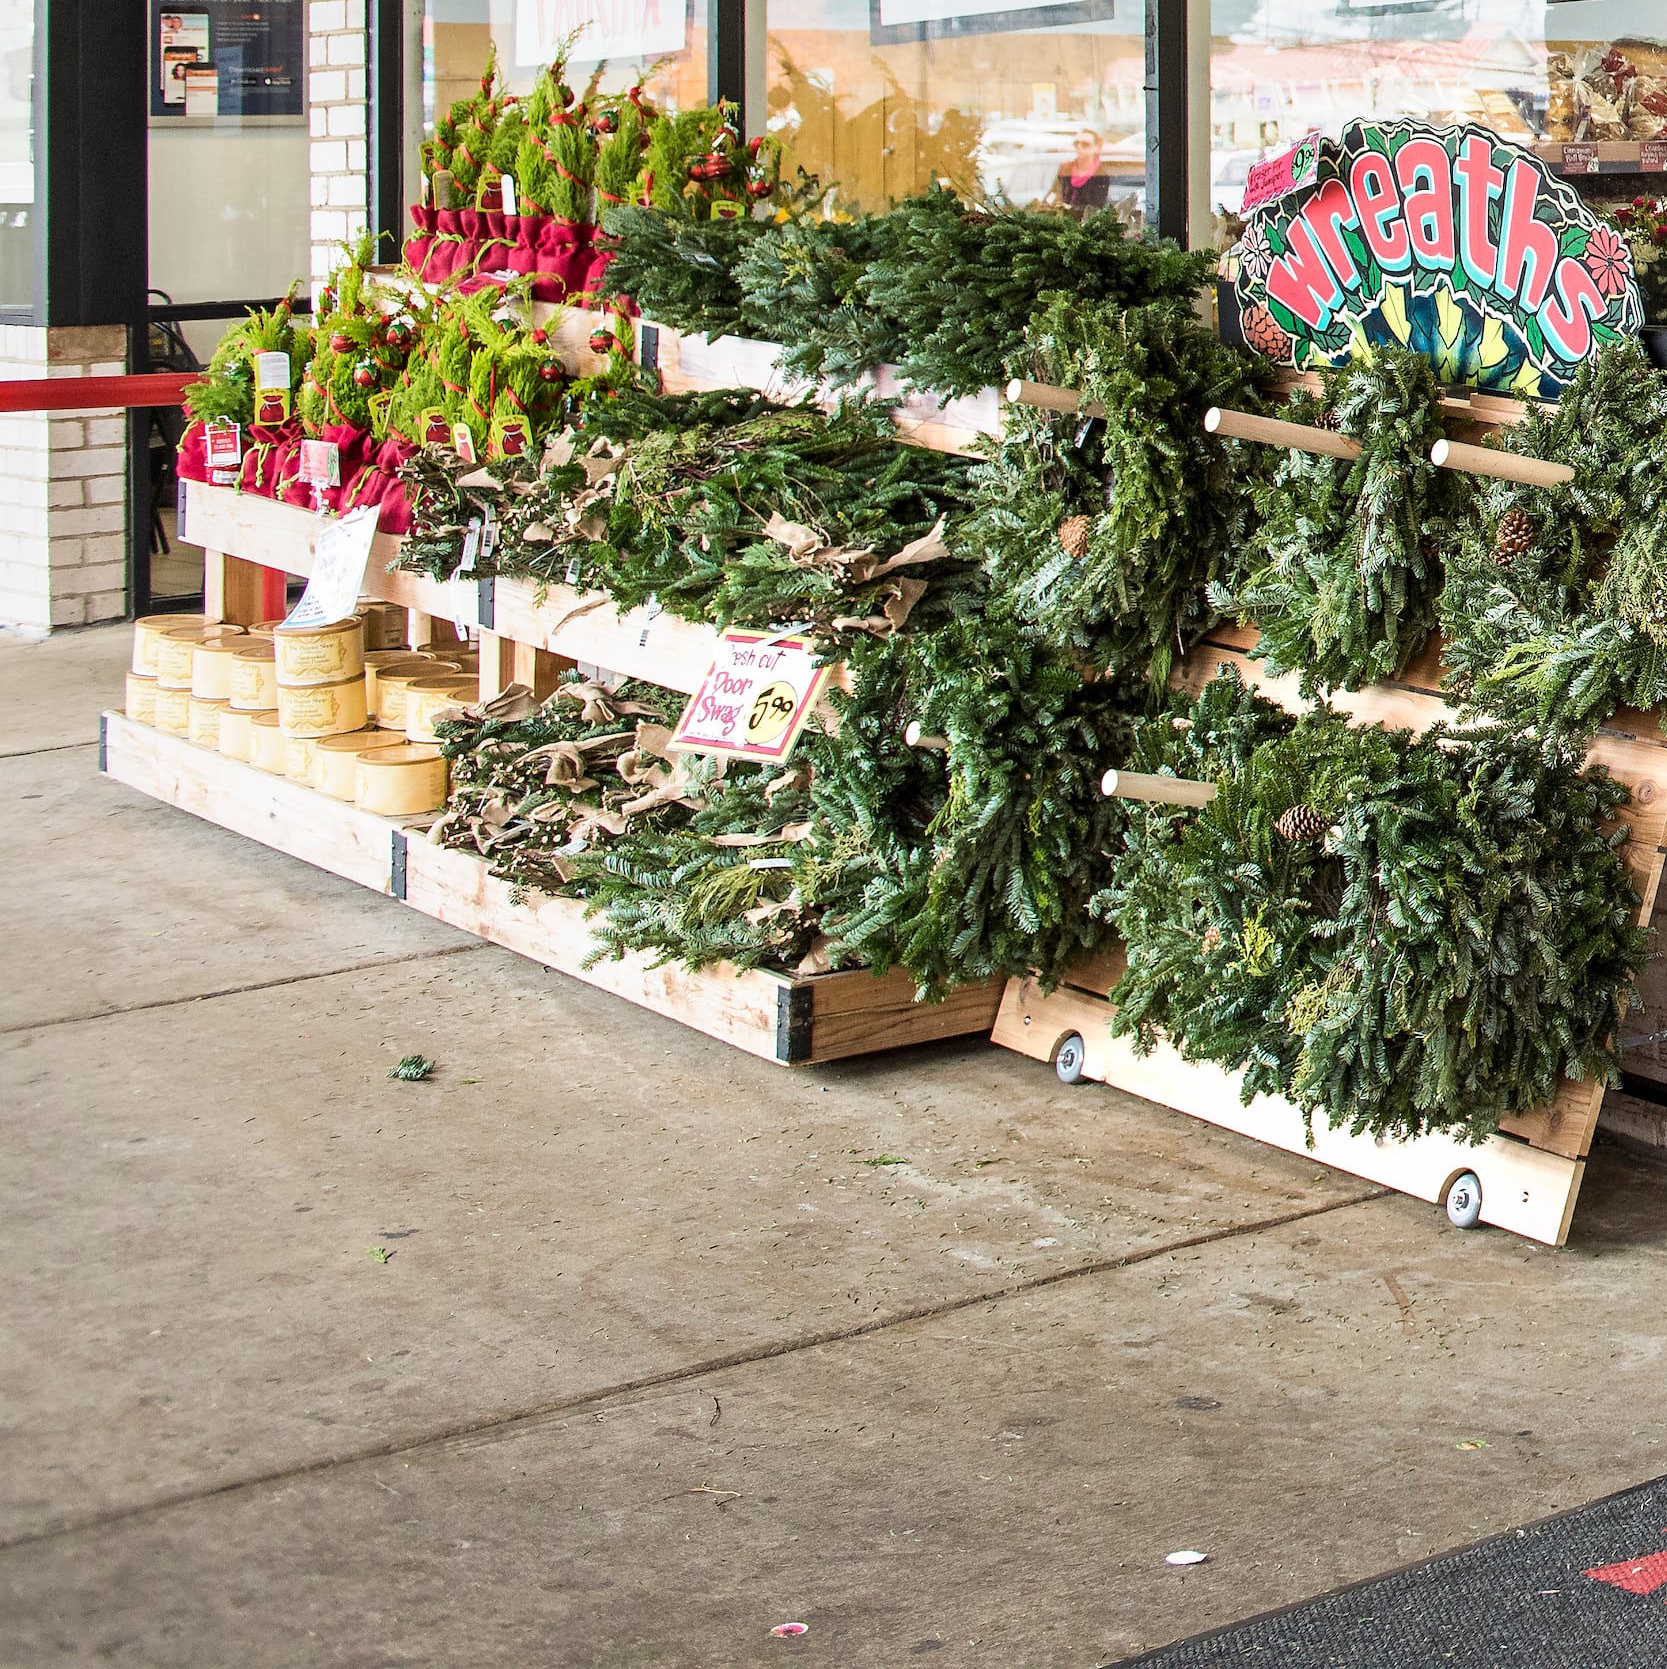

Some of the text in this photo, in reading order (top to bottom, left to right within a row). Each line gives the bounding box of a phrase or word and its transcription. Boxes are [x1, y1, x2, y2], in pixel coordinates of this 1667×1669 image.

[1265, 133, 1609, 363] wreaths
[731, 644, 787, 672] resh cut
[713, 671, 753, 696] Door
[697, 695, 745, 737] Swag
